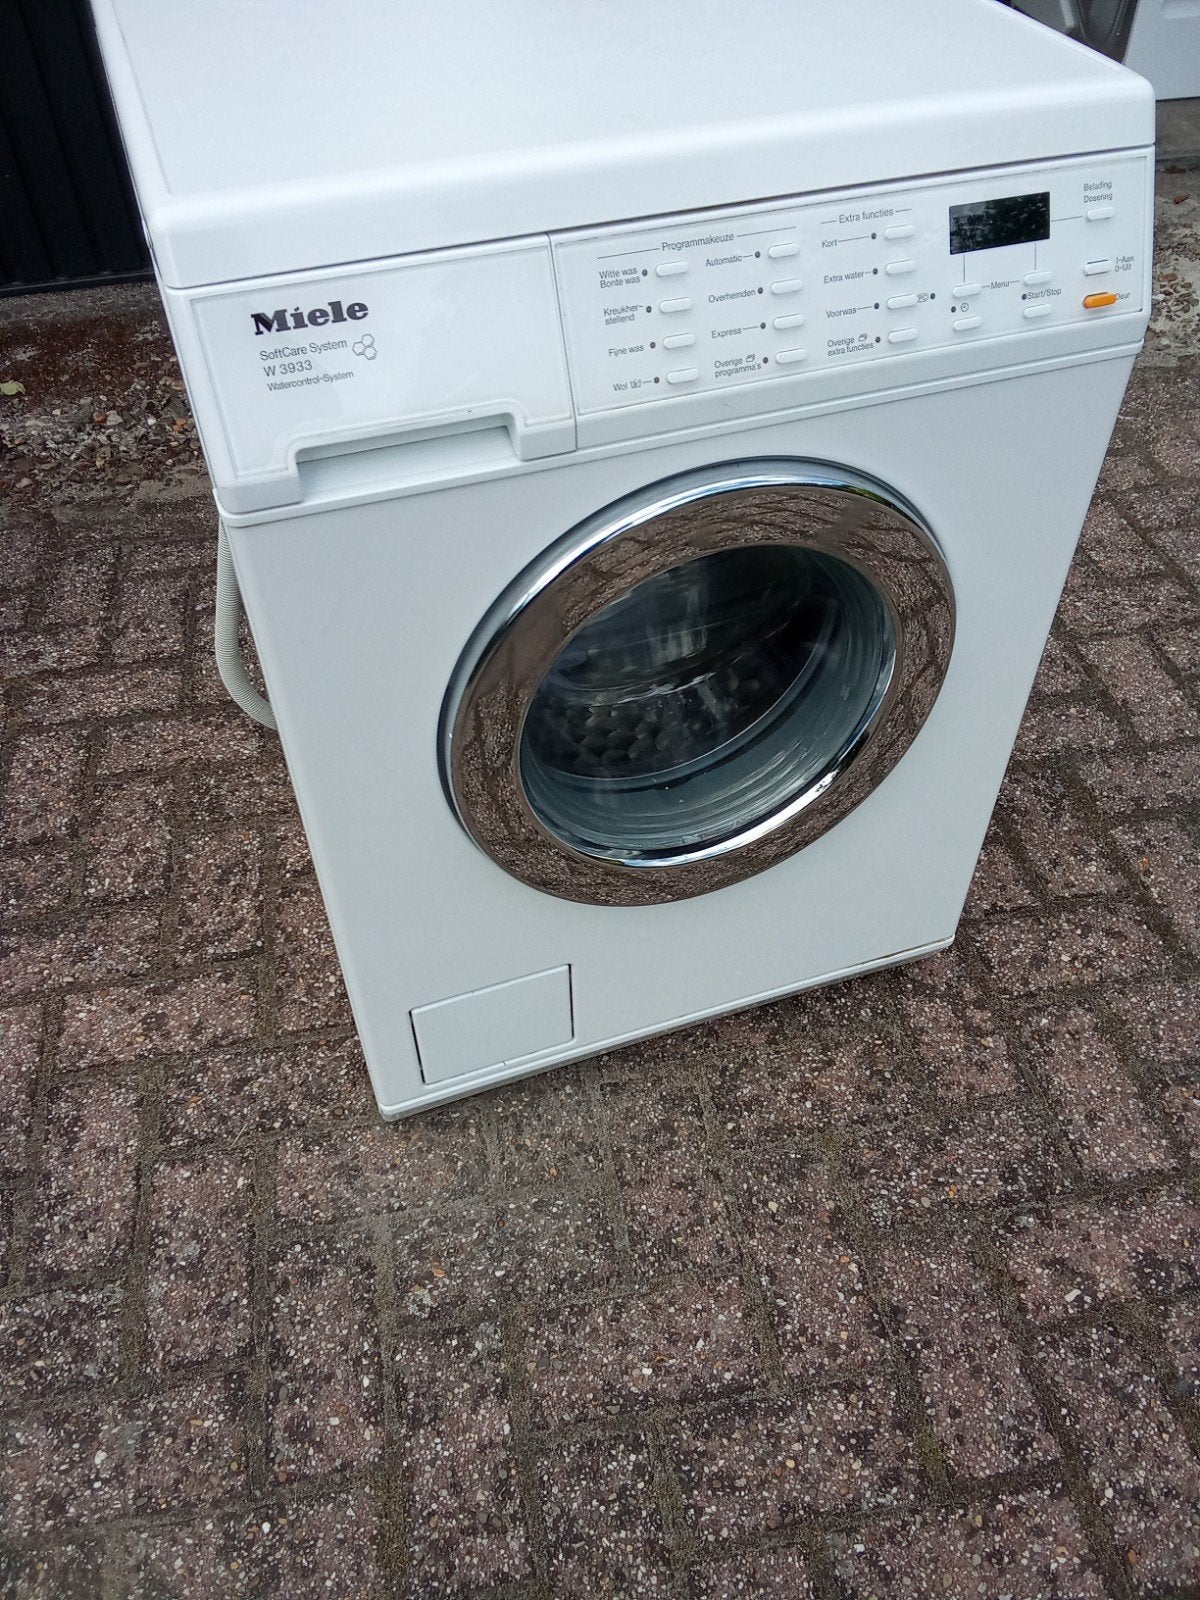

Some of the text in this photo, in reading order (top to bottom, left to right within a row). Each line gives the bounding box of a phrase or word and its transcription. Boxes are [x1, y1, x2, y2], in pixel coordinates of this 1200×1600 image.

[1083, 181, 1112, 191] Belading
[1083, 192, 1113, 203] Dosering
[838, 208, 894, 224] Extra functies
[661, 232, 735, 251] Programmakeuze
[821, 239, 838, 248] Kort
[705, 254, 743, 268] Automatic
[599, 267, 637, 280] Witte was
[823, 270, 864, 284] Extra water
[600, 275, 641, 289] Bonte was
[990, 280, 1010, 290] Menu
[708, 289, 756, 303] Overhemden
[1027, 288, 1062, 300] Start/Stop
[603, 305, 643, 316] Kreukher-
[825, 307, 857, 318] Voorwas
[250, 300, 369, 336] Miele
[605, 314, 635, 326] stellend
[711, 327, 742, 339] Express
[826, 336, 855, 348] Overige
[260, 339, 348, 361] SoftCare System
[608, 344, 644, 358] Fijne was
[827, 342, 874, 357] extra functies
[263, 359, 313, 377] W 3933
[714, 357, 743, 369] Overige
[714, 362, 762, 378] programma's
[267, 370, 355, 391] Watercontrol-System
[613, 382, 628, 392] Wol
